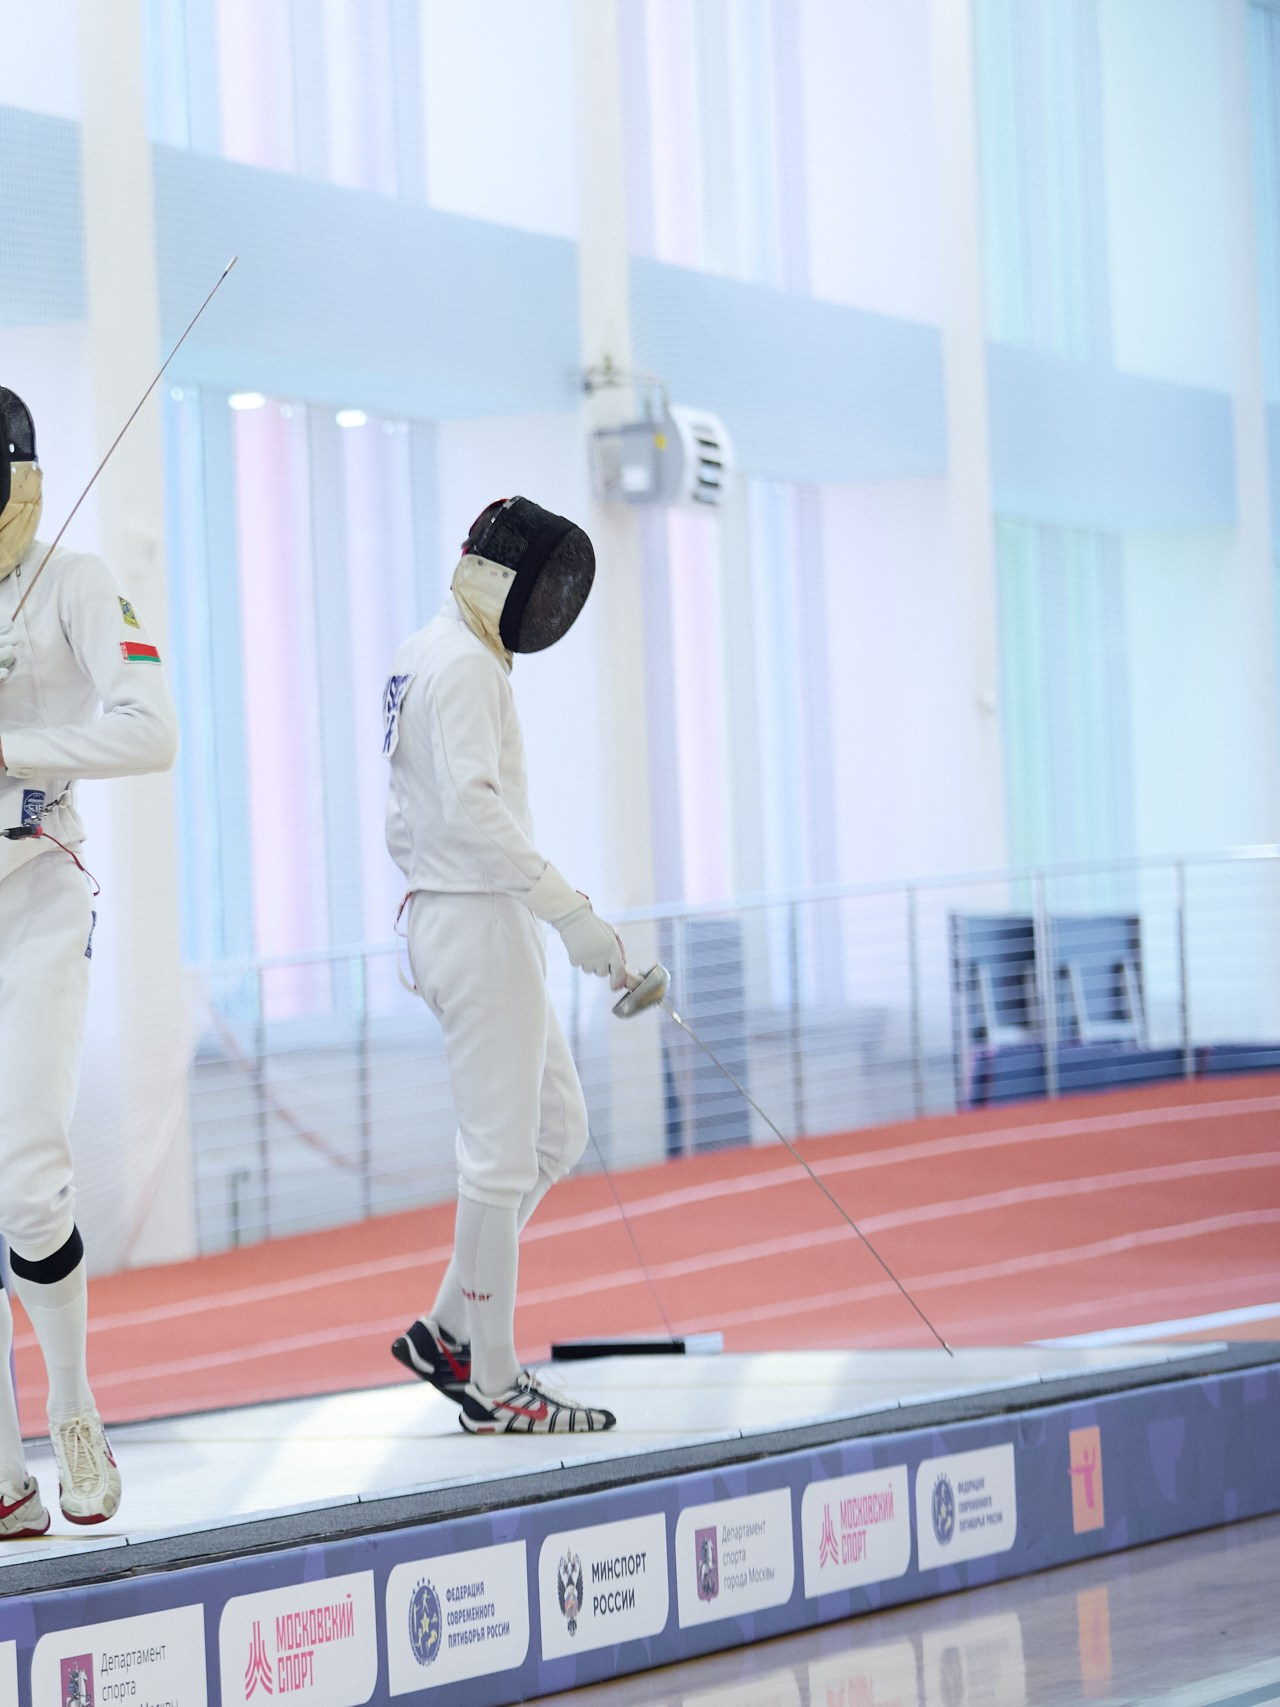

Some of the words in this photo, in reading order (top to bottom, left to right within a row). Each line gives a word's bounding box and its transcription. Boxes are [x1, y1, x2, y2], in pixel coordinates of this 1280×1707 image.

[840, 1482, 894, 1530] МОСКОВСКИЙ
[721, 1521, 766, 1546] Департамент
[842, 1530, 867, 1564] СПОРТ
[591, 1552, 646, 1584] МИНСПОРТ
[722, 1549, 746, 1568] спорта
[446, 1581, 485, 1603] ФЕДЕРАЦИЯ
[723, 1573, 748, 1593] города
[748, 1567, 775, 1585] Москвы
[447, 1603, 495, 1626] СОВРЕМЕННОГО
[593, 1588, 635, 1617] РОССИИ
[276, 1593, 354, 1653] МОСКОВСКИЙ
[448, 1625, 486, 1648] ПЯТИБОРЬЯ
[486, 1622, 510, 1640] РОССИИ
[100, 1645, 167, 1678] Департамент
[277, 1650, 314, 1693] СПОРТ
[102, 1680, 136, 1704] спорта
